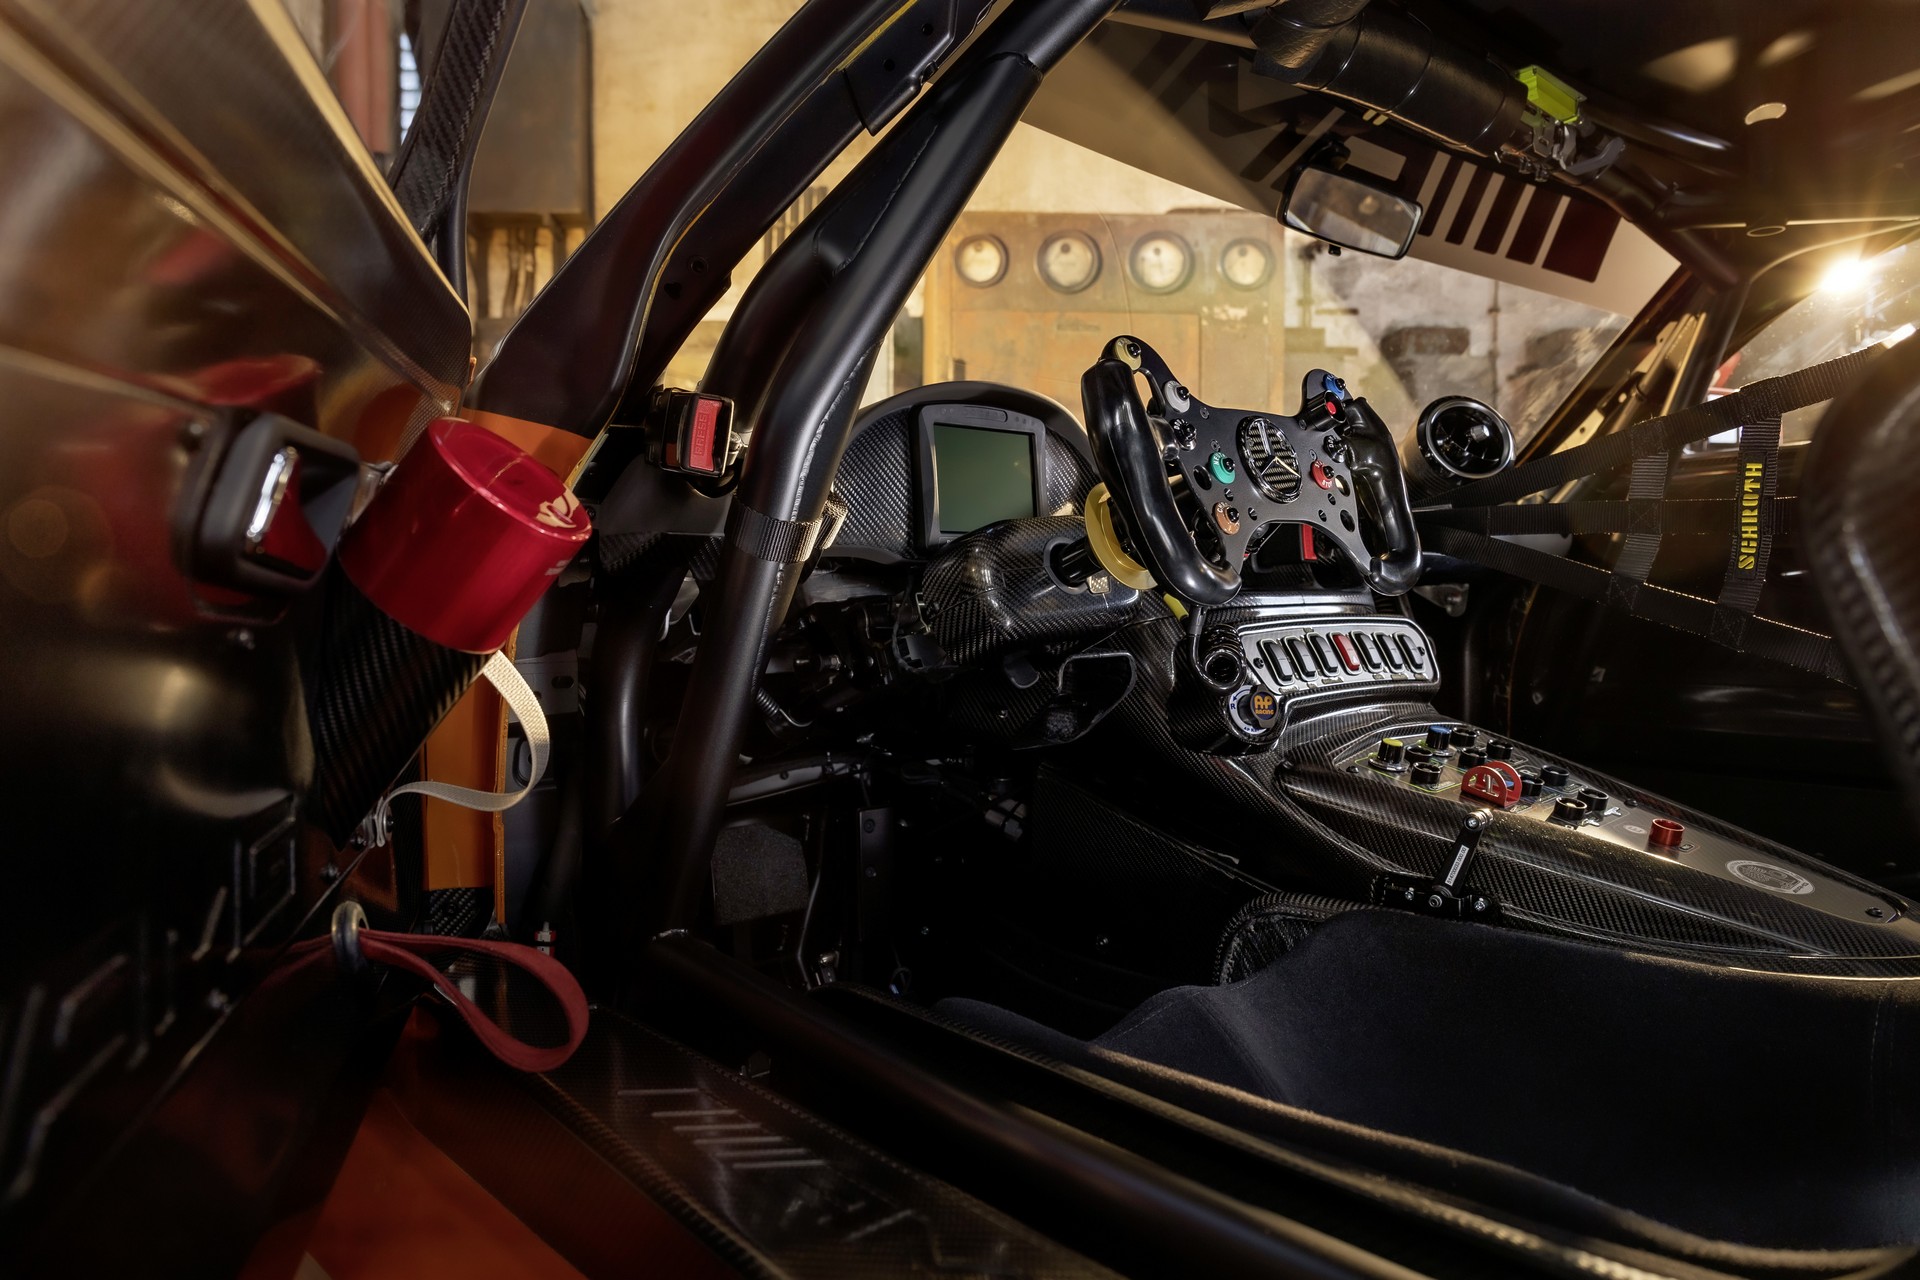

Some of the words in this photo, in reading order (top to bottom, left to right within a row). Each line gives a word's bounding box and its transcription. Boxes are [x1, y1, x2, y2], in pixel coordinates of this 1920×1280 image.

[694, 412, 709, 456] PRESS
[1738, 463, 1762, 570] SCHROTH
[1254, 695, 1273, 709] AP
